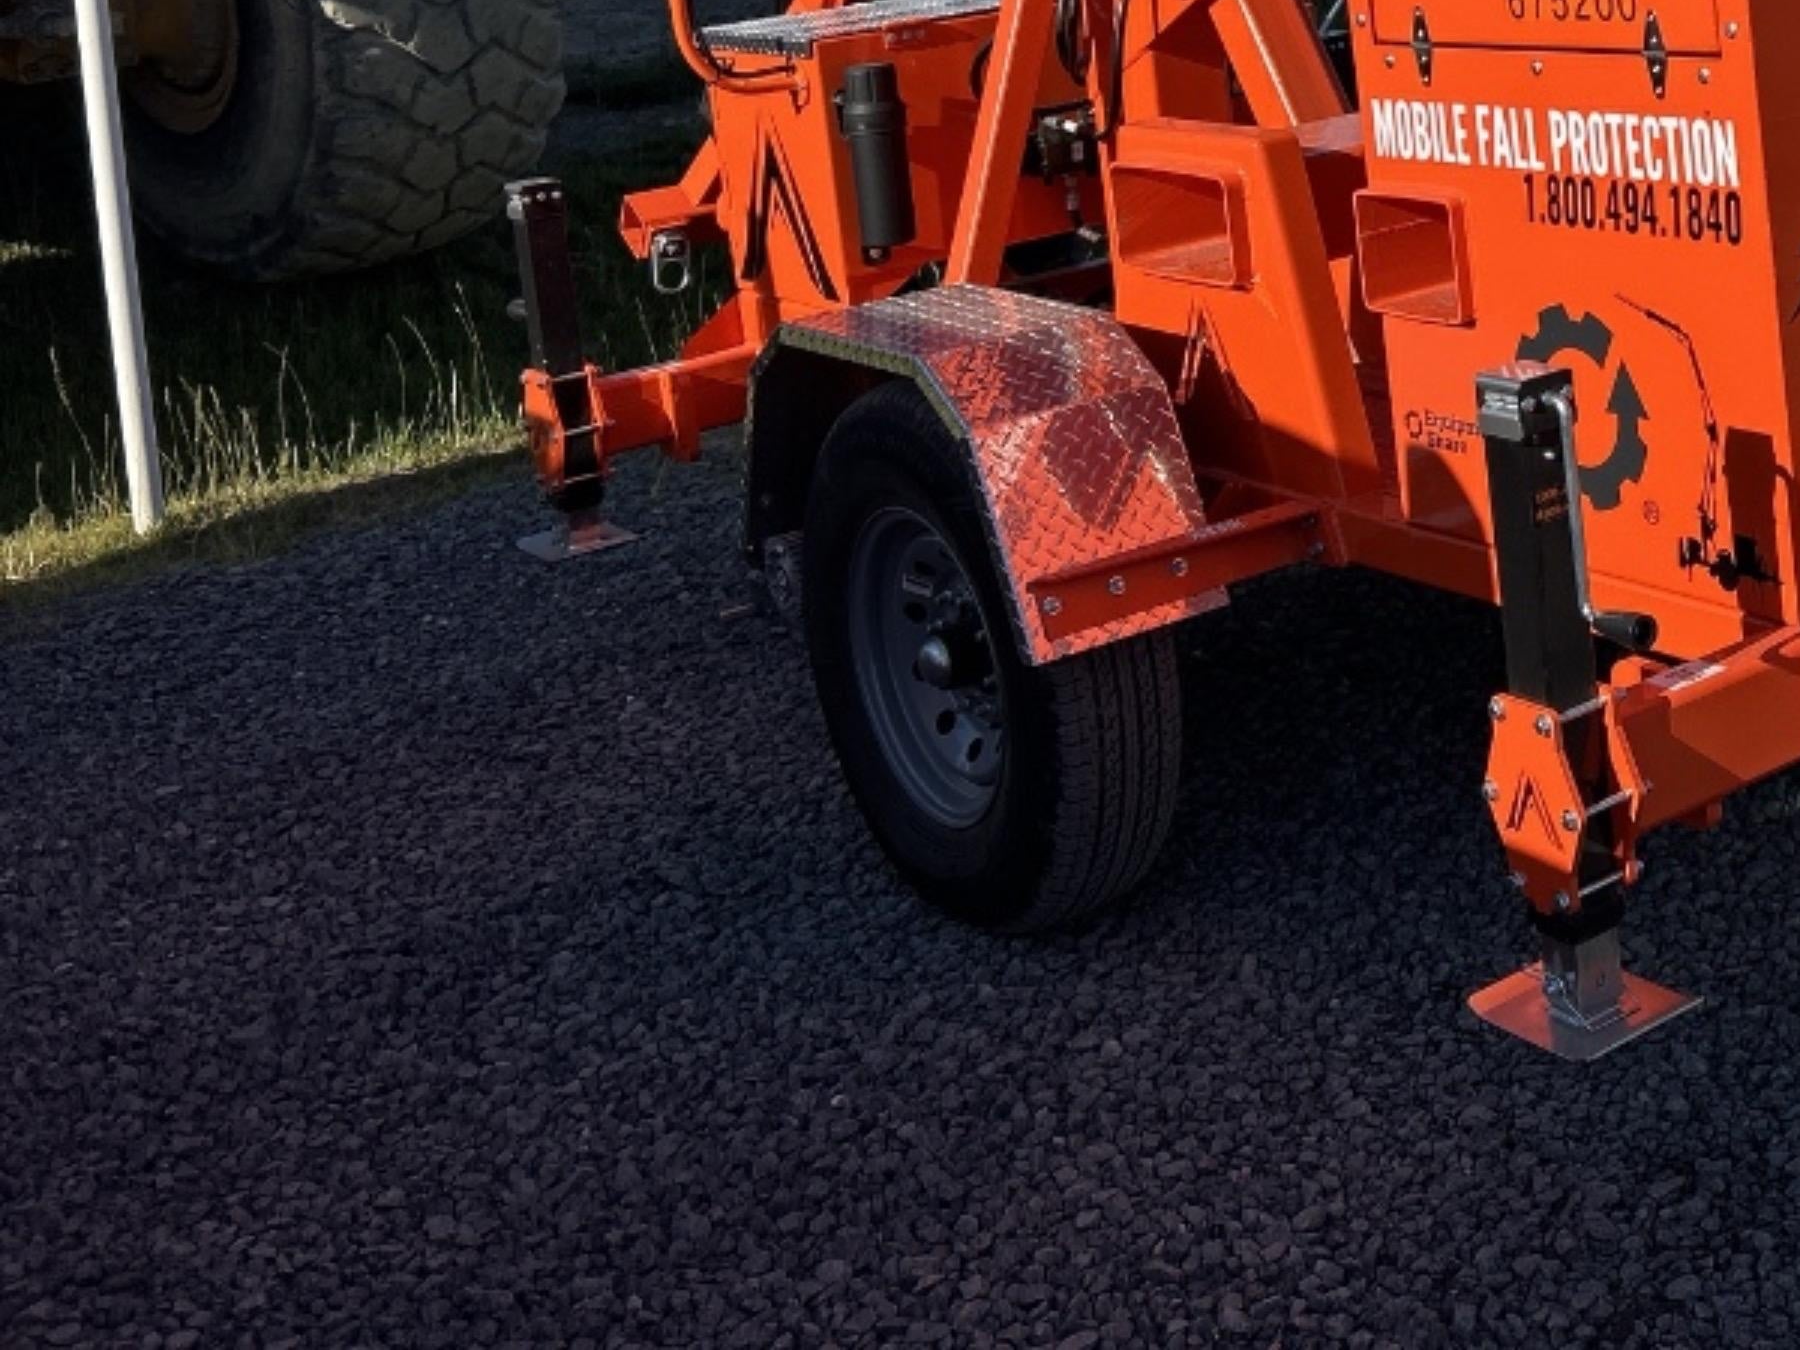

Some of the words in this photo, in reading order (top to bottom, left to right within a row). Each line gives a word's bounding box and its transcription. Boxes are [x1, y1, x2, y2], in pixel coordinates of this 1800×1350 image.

[1370, 97, 1471, 166] MOBILE
[1474, 103, 1546, 172] FALL
[1547, 109, 1740, 188] PROTECTION
[1523, 173, 1742, 246] 1.800.494.1840
